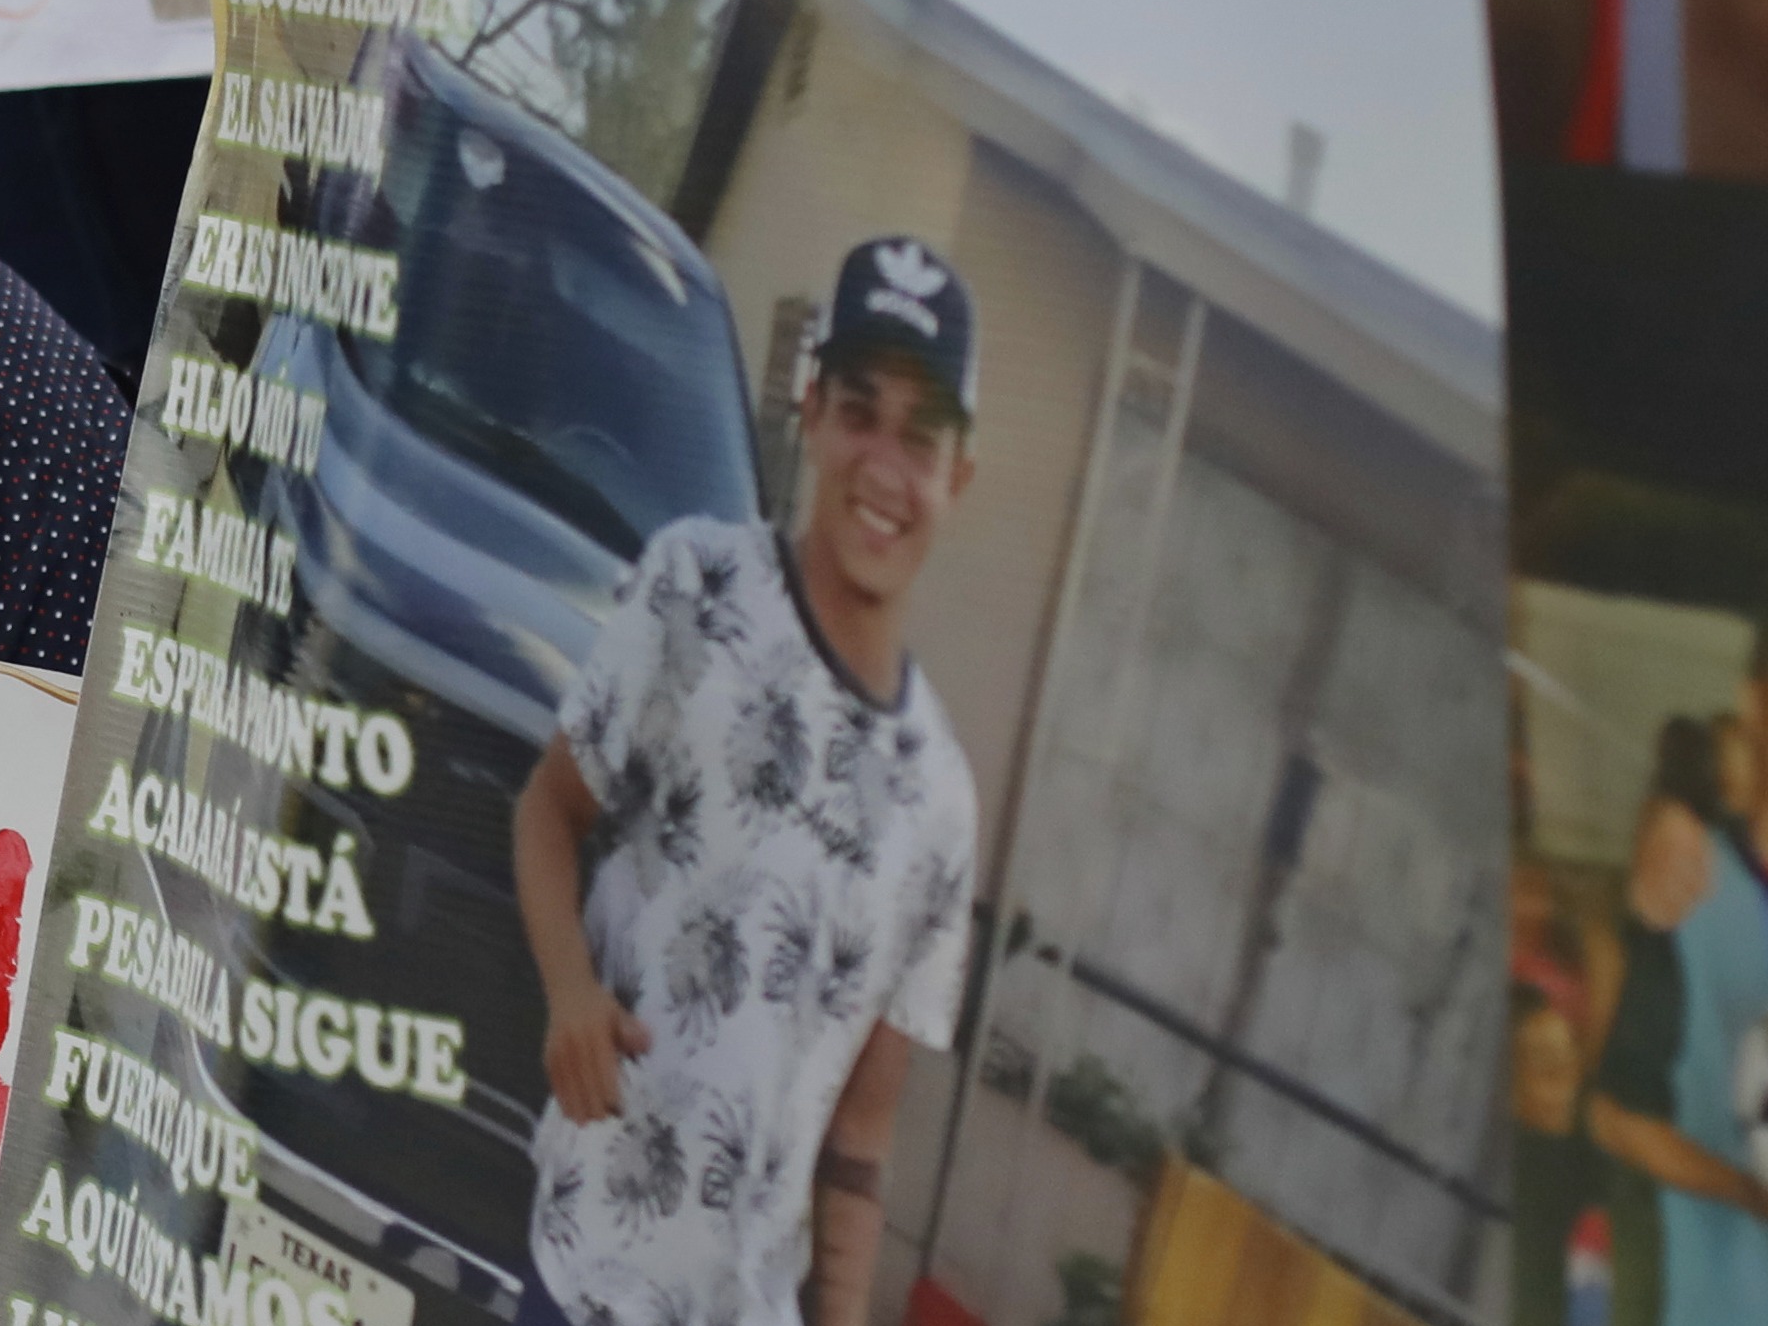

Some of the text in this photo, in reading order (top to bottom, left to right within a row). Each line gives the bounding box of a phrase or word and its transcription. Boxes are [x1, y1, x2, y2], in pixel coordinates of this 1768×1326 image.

[218, 73, 255, 144] EL
[189, 216, 398, 339] ERES INOCENTE
[165, 359, 249, 441] HIJO
[138, 493, 270, 599] FAMILIA
[114, 627, 415, 796] ESPERA PRONTO
[69, 895, 467, 1103] PESADILLA SIGUE
[45, 1030, 260, 1200] FUERTE QUE
[281, 1231, 351, 1292] TEXAS
